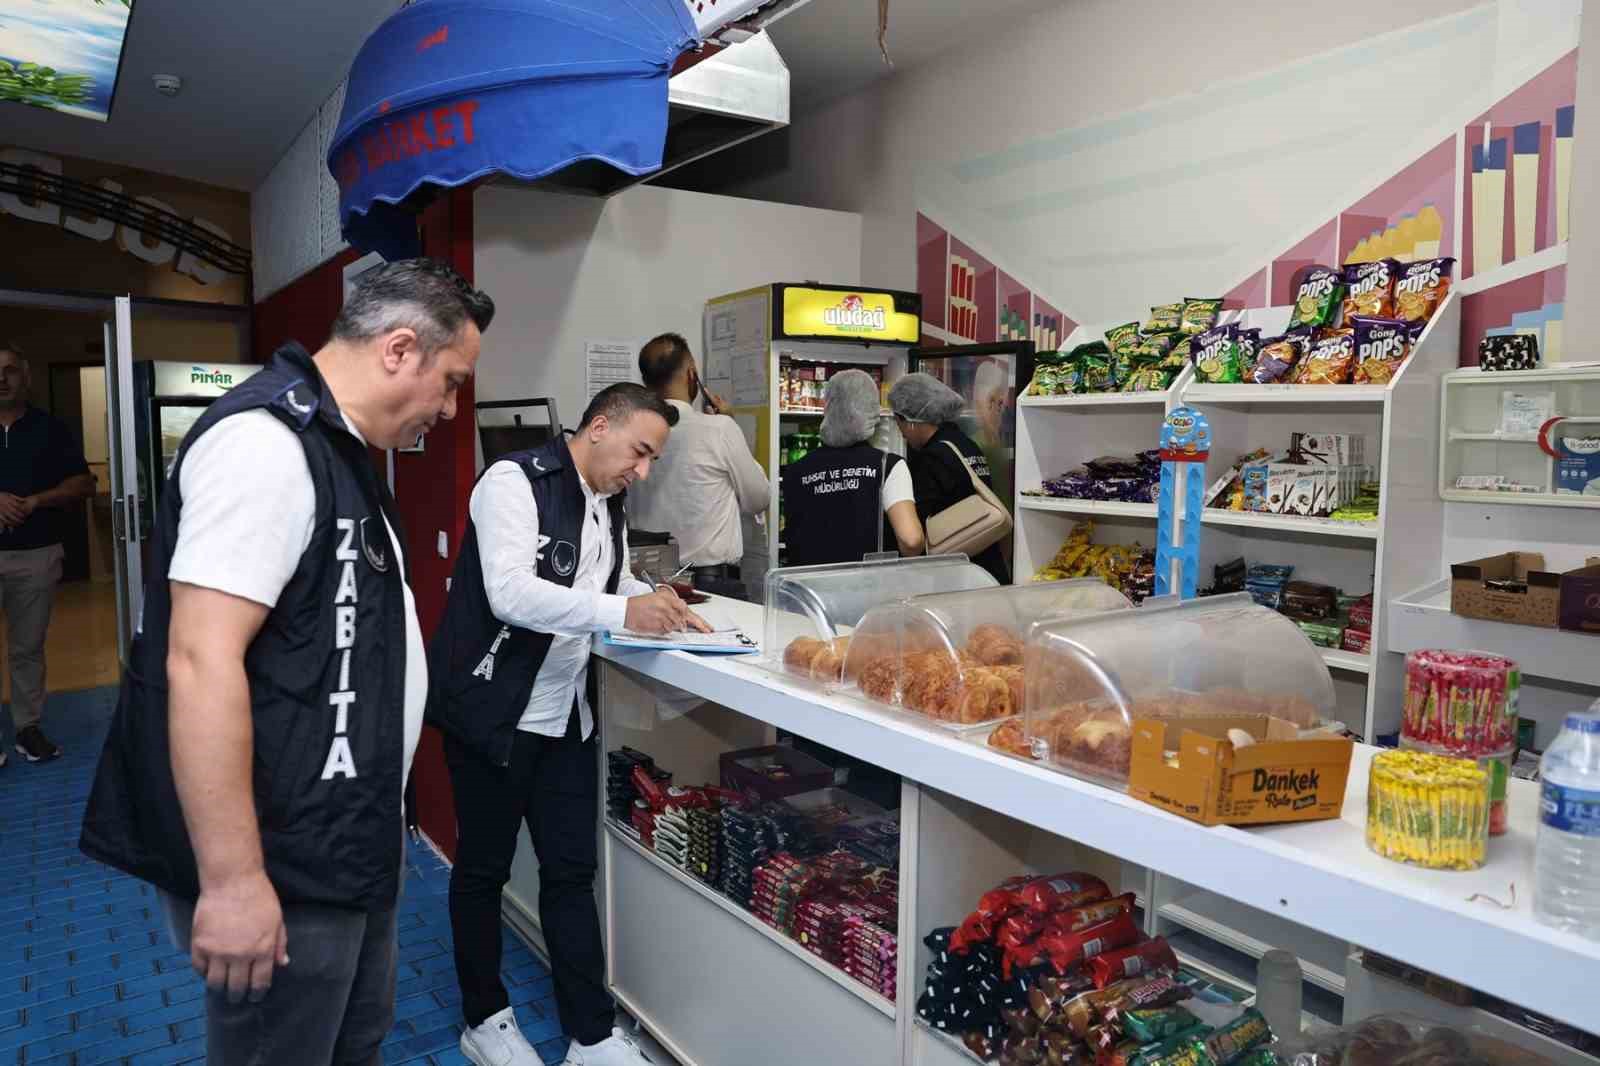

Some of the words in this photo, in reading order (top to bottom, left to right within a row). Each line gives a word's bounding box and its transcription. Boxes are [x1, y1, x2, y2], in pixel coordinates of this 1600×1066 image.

[1298, 276, 1336, 299] POPS
[1351, 267, 1390, 300] POPS
[1397, 267, 1441, 294] POPS
[824, 305, 885, 330] uludağ
[1197, 335, 1233, 367] POPS
[1359, 335, 1405, 364] POPS
[829, 470, 841, 480] VE
[842, 465, 876, 479] DENETİM
[1252, 768, 1320, 794] Dankek
